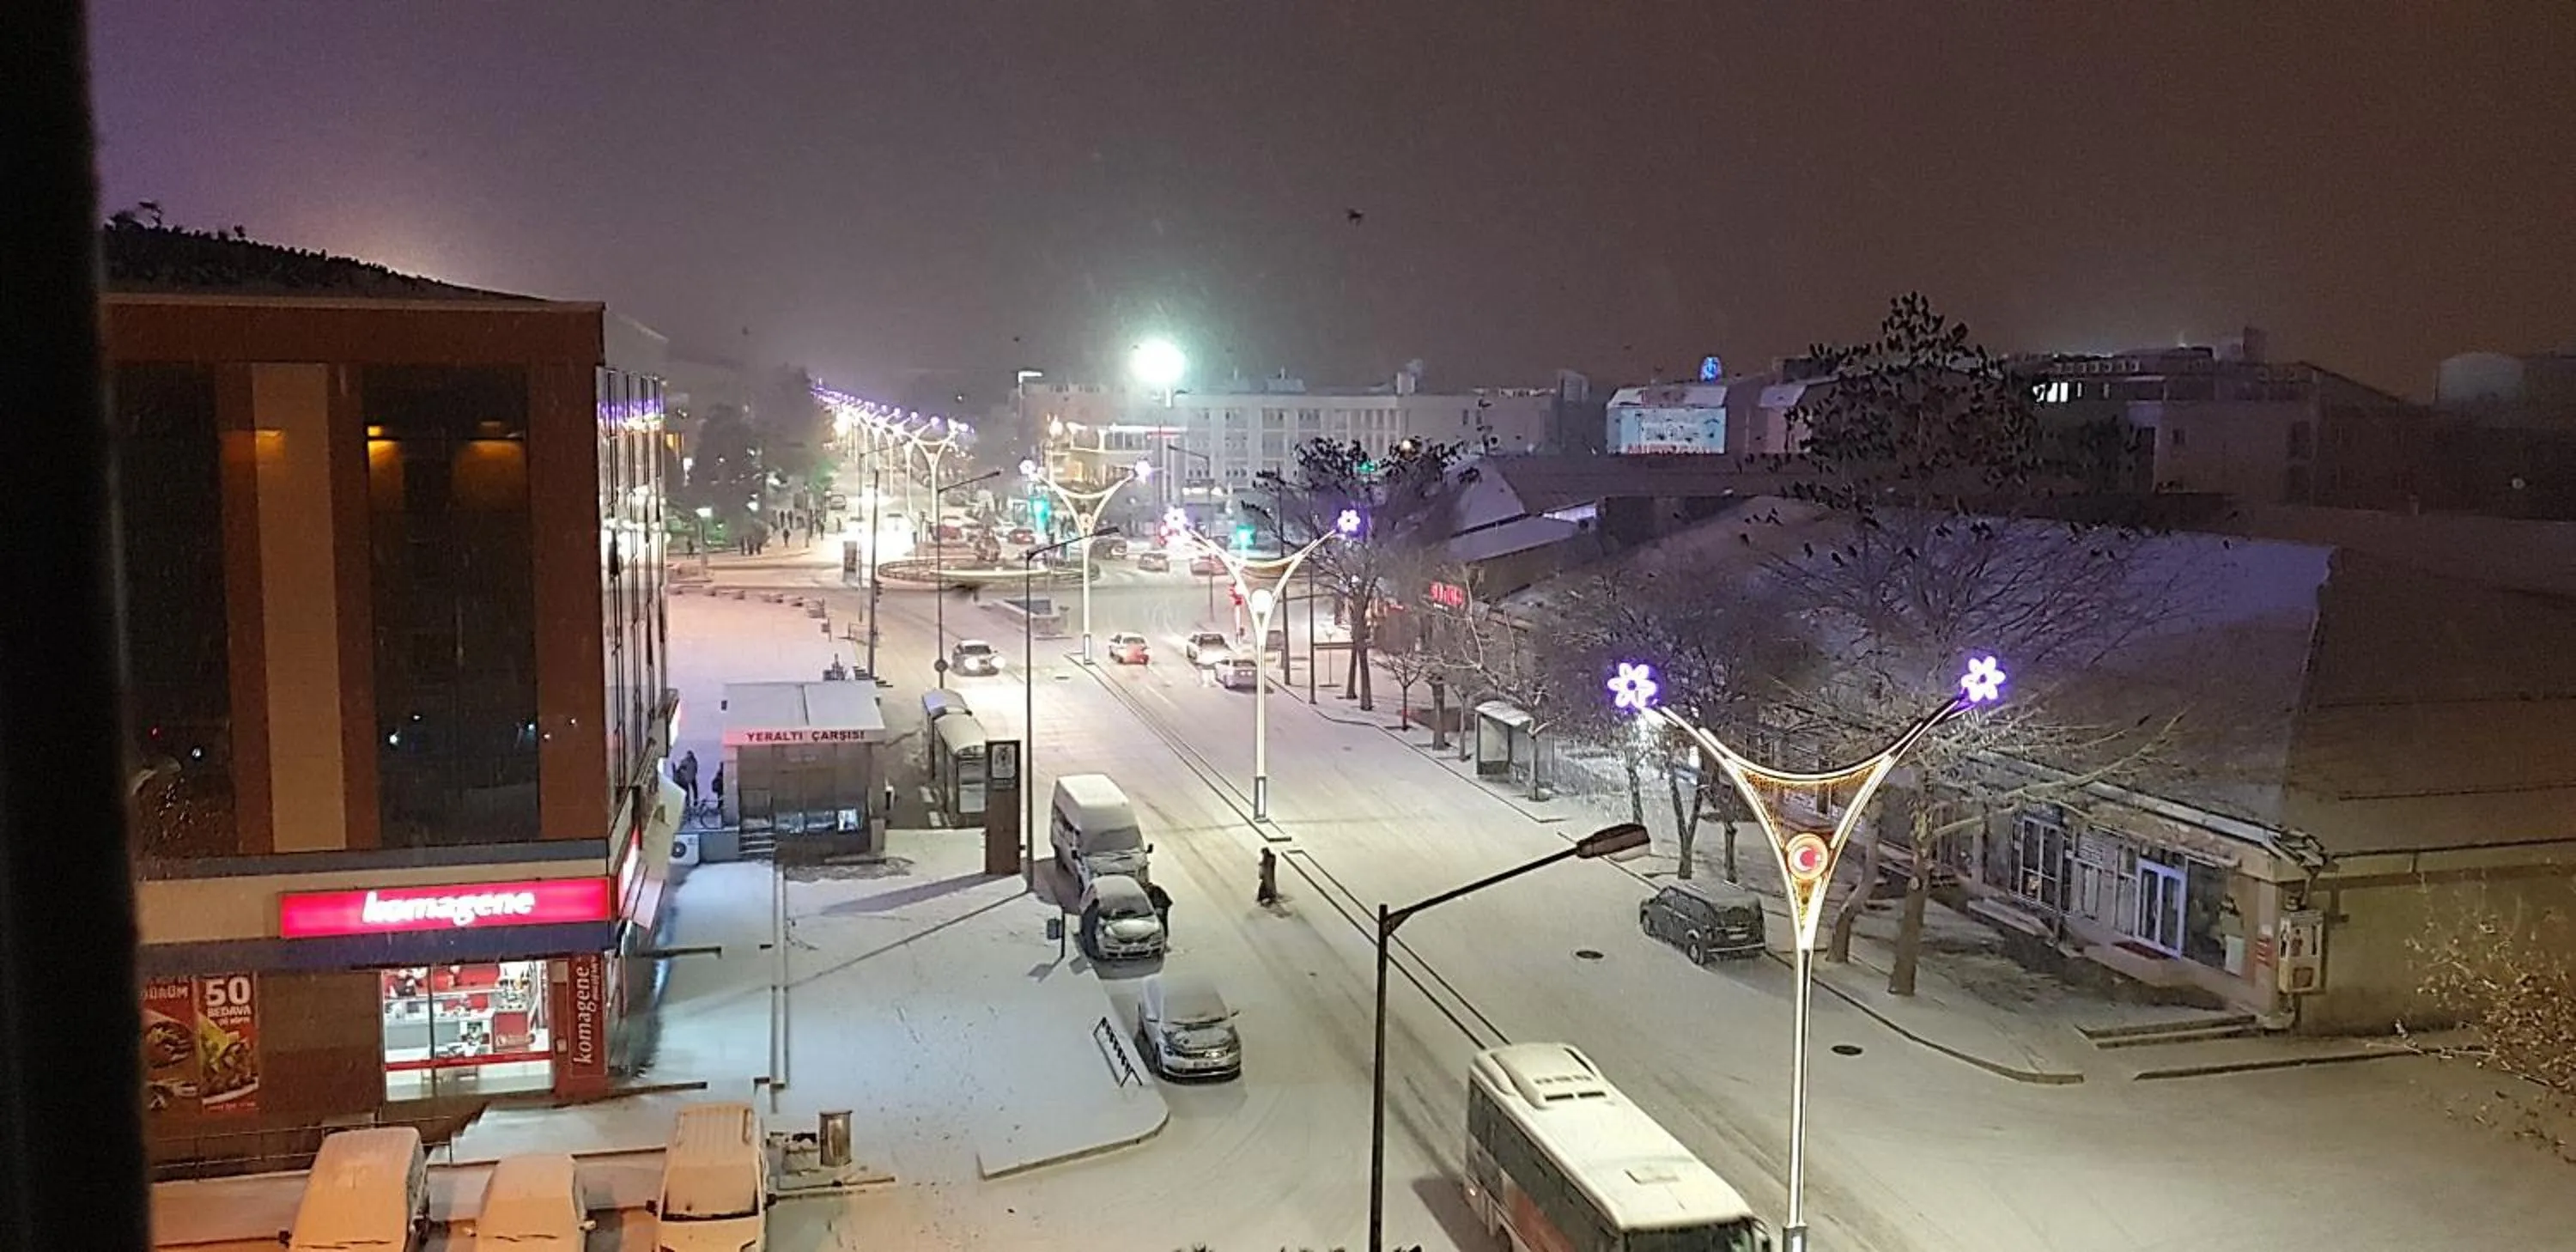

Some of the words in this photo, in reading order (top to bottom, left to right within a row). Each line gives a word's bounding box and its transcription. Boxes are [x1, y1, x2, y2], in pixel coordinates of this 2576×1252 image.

[746, 731, 803, 742] YERALTI
[362, 890, 535, 927] komagene
[205, 976, 252, 1007] 50
[573, 966, 597, 1064] komagene
